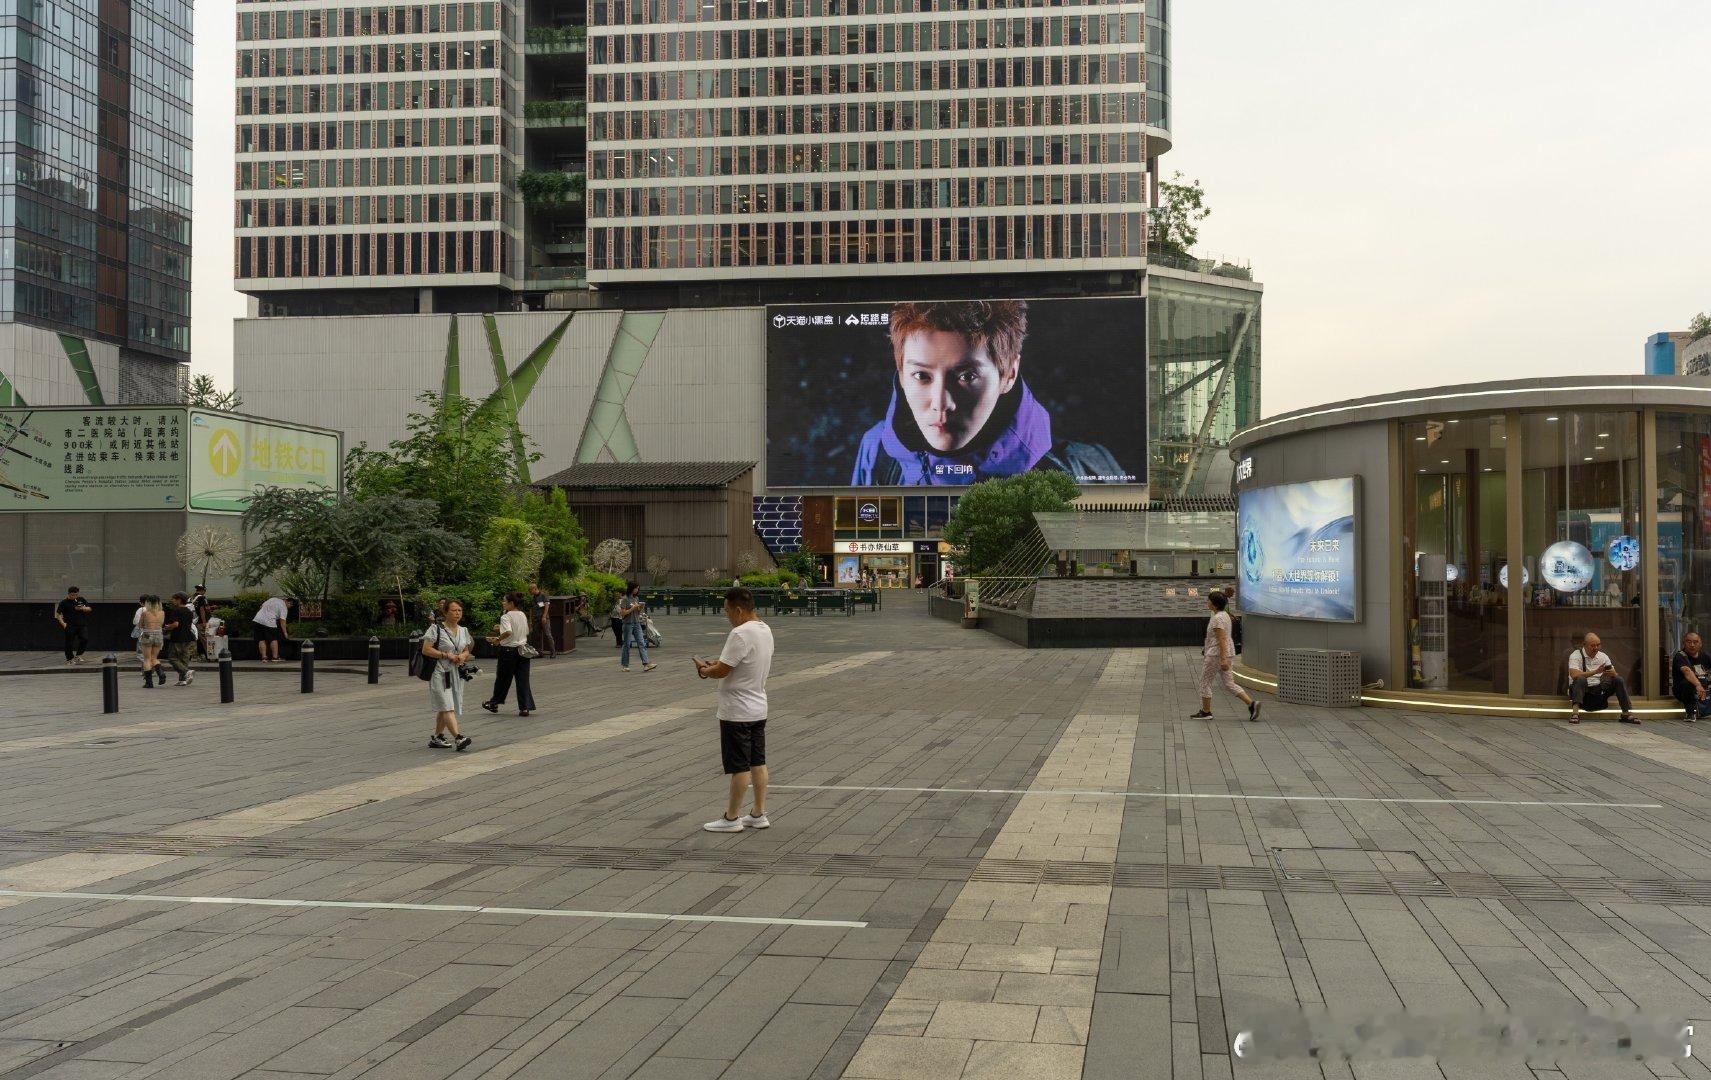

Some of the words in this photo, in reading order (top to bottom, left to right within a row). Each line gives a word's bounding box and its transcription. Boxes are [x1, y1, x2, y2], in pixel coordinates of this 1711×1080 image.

[786, 314, 834, 326] 天猫小黑盒
[251, 438, 326, 474] 地铁C口
[935, 464, 973, 475] 留下回响
[860, 542, 900, 552] 书亦烧仙草
[1309, 539, 1339, 552] 未来已来
